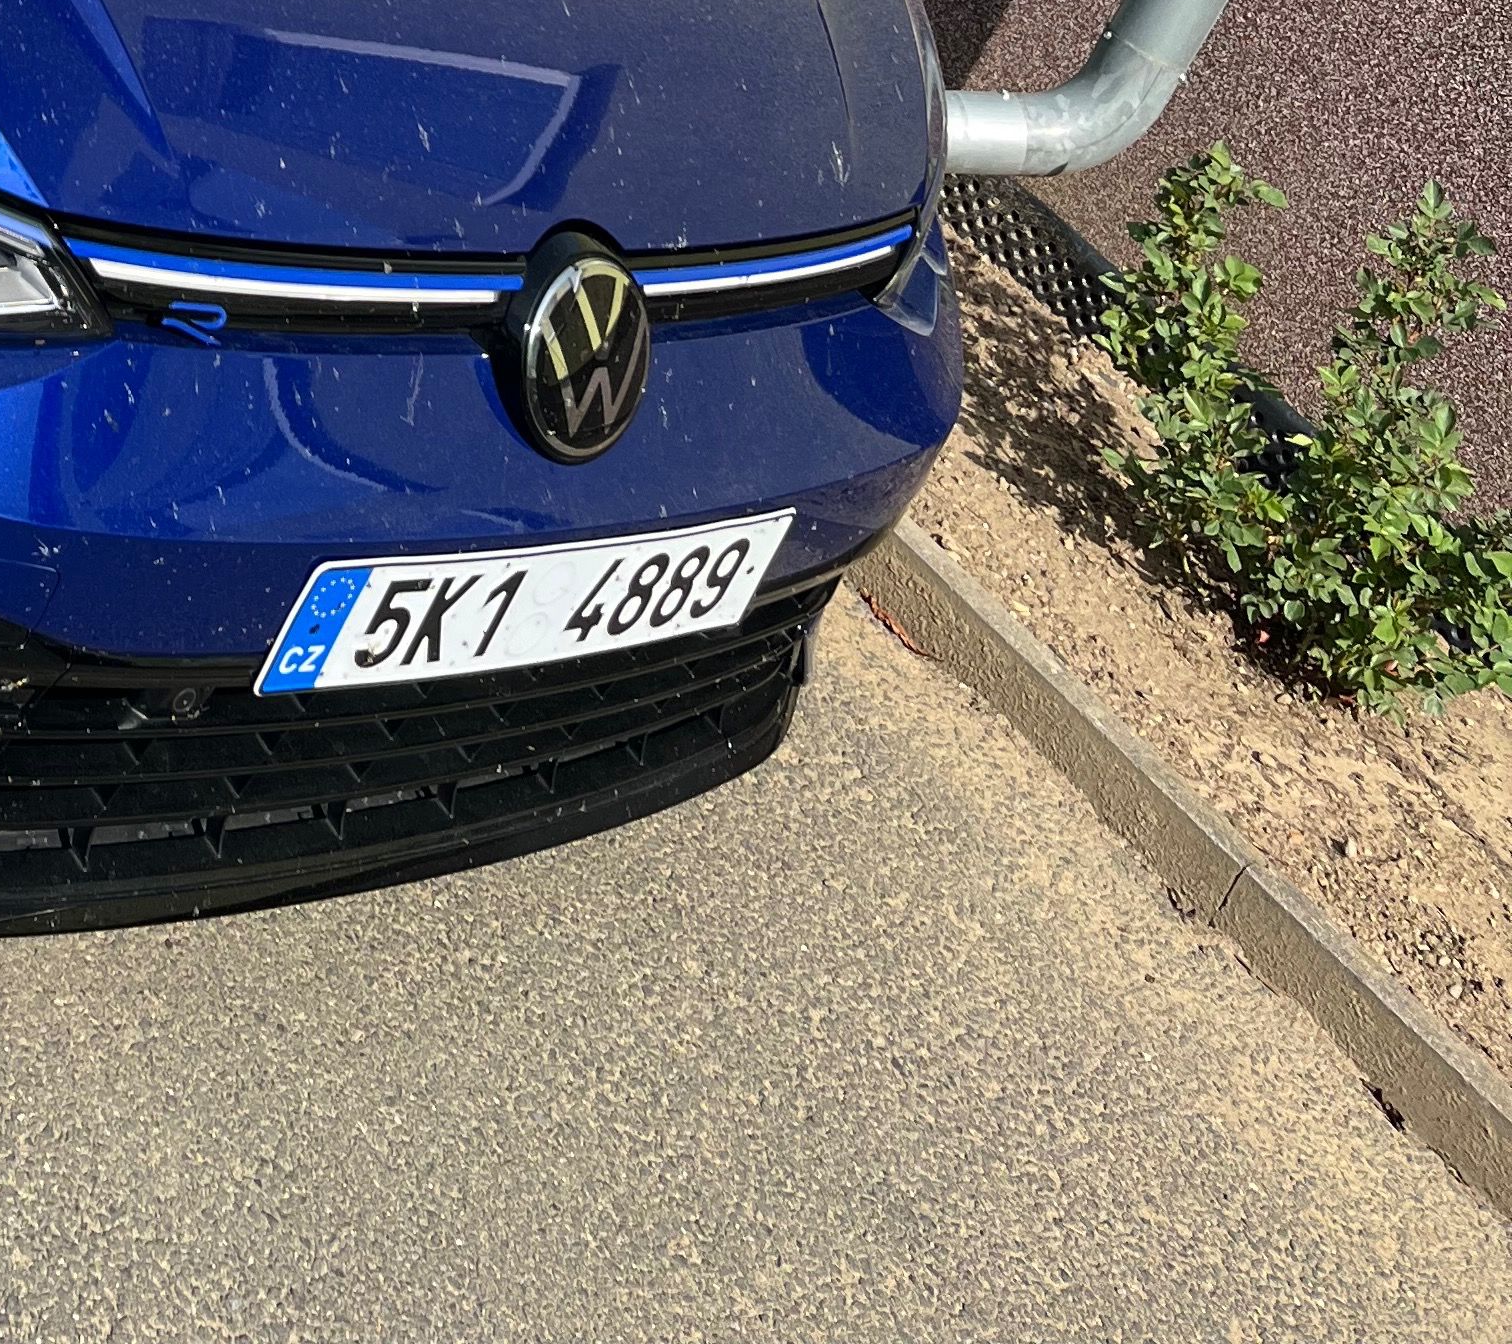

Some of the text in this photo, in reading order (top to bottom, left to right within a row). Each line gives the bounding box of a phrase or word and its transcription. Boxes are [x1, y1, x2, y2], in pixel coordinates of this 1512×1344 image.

[539, 274, 648, 438] VW
[278, 538, 751, 674] CZ 5K1 4889
